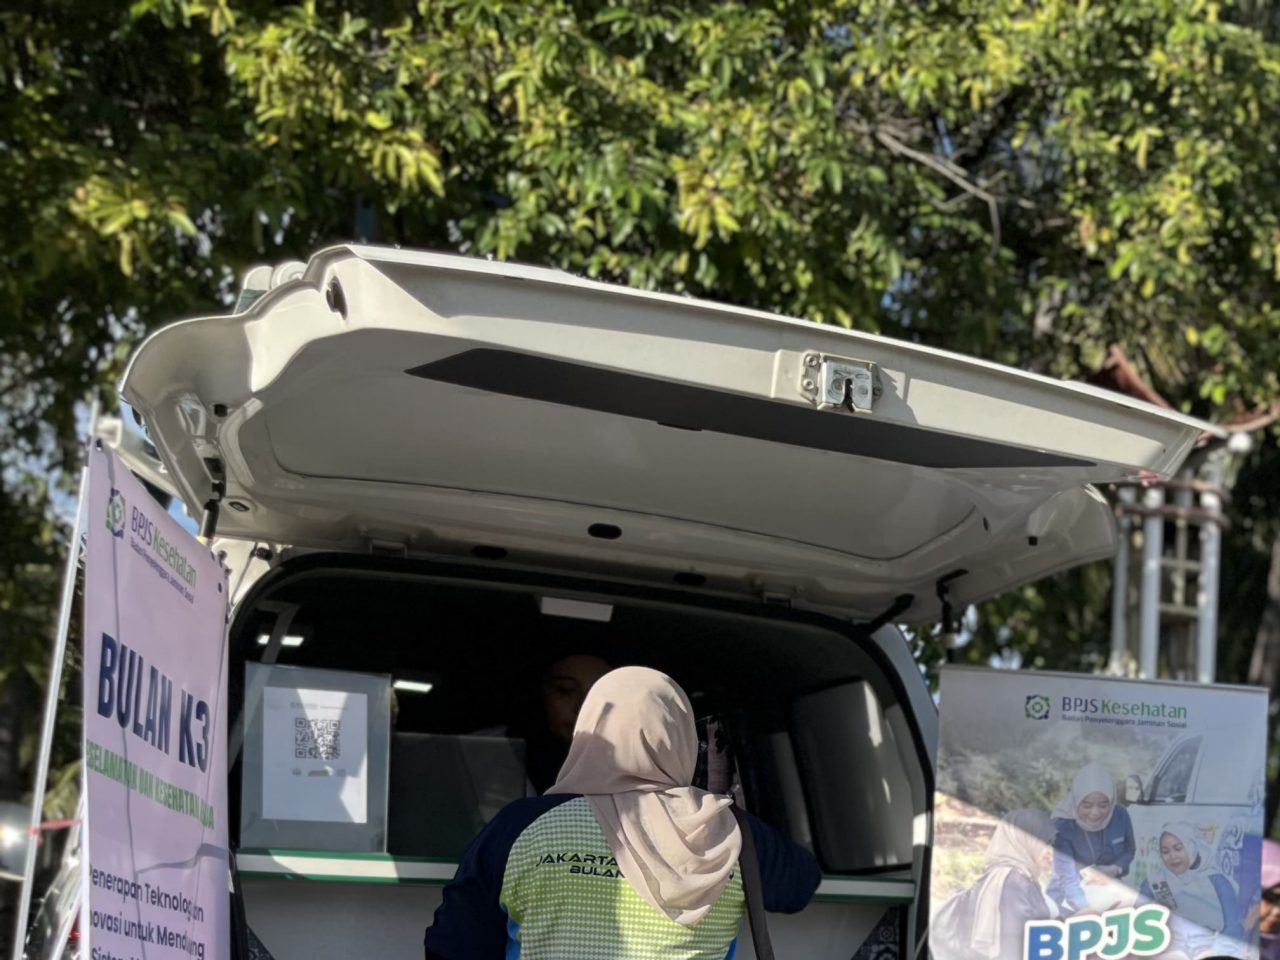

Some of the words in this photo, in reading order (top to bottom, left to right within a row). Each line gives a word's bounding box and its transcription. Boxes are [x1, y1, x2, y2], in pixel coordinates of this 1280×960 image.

[131, 506, 153, 546] BPJS
[152, 527, 197, 588] Kesehatan
[97, 632, 172, 755] BULAN
[179, 688, 210, 773] K3
[1061, 696, 1098, 713] BPJS
[1101, 699, 1188, 719] Kesehatan
[536, 852, 618, 867] JAKARTA
[124, 919, 154, 943] untuk
